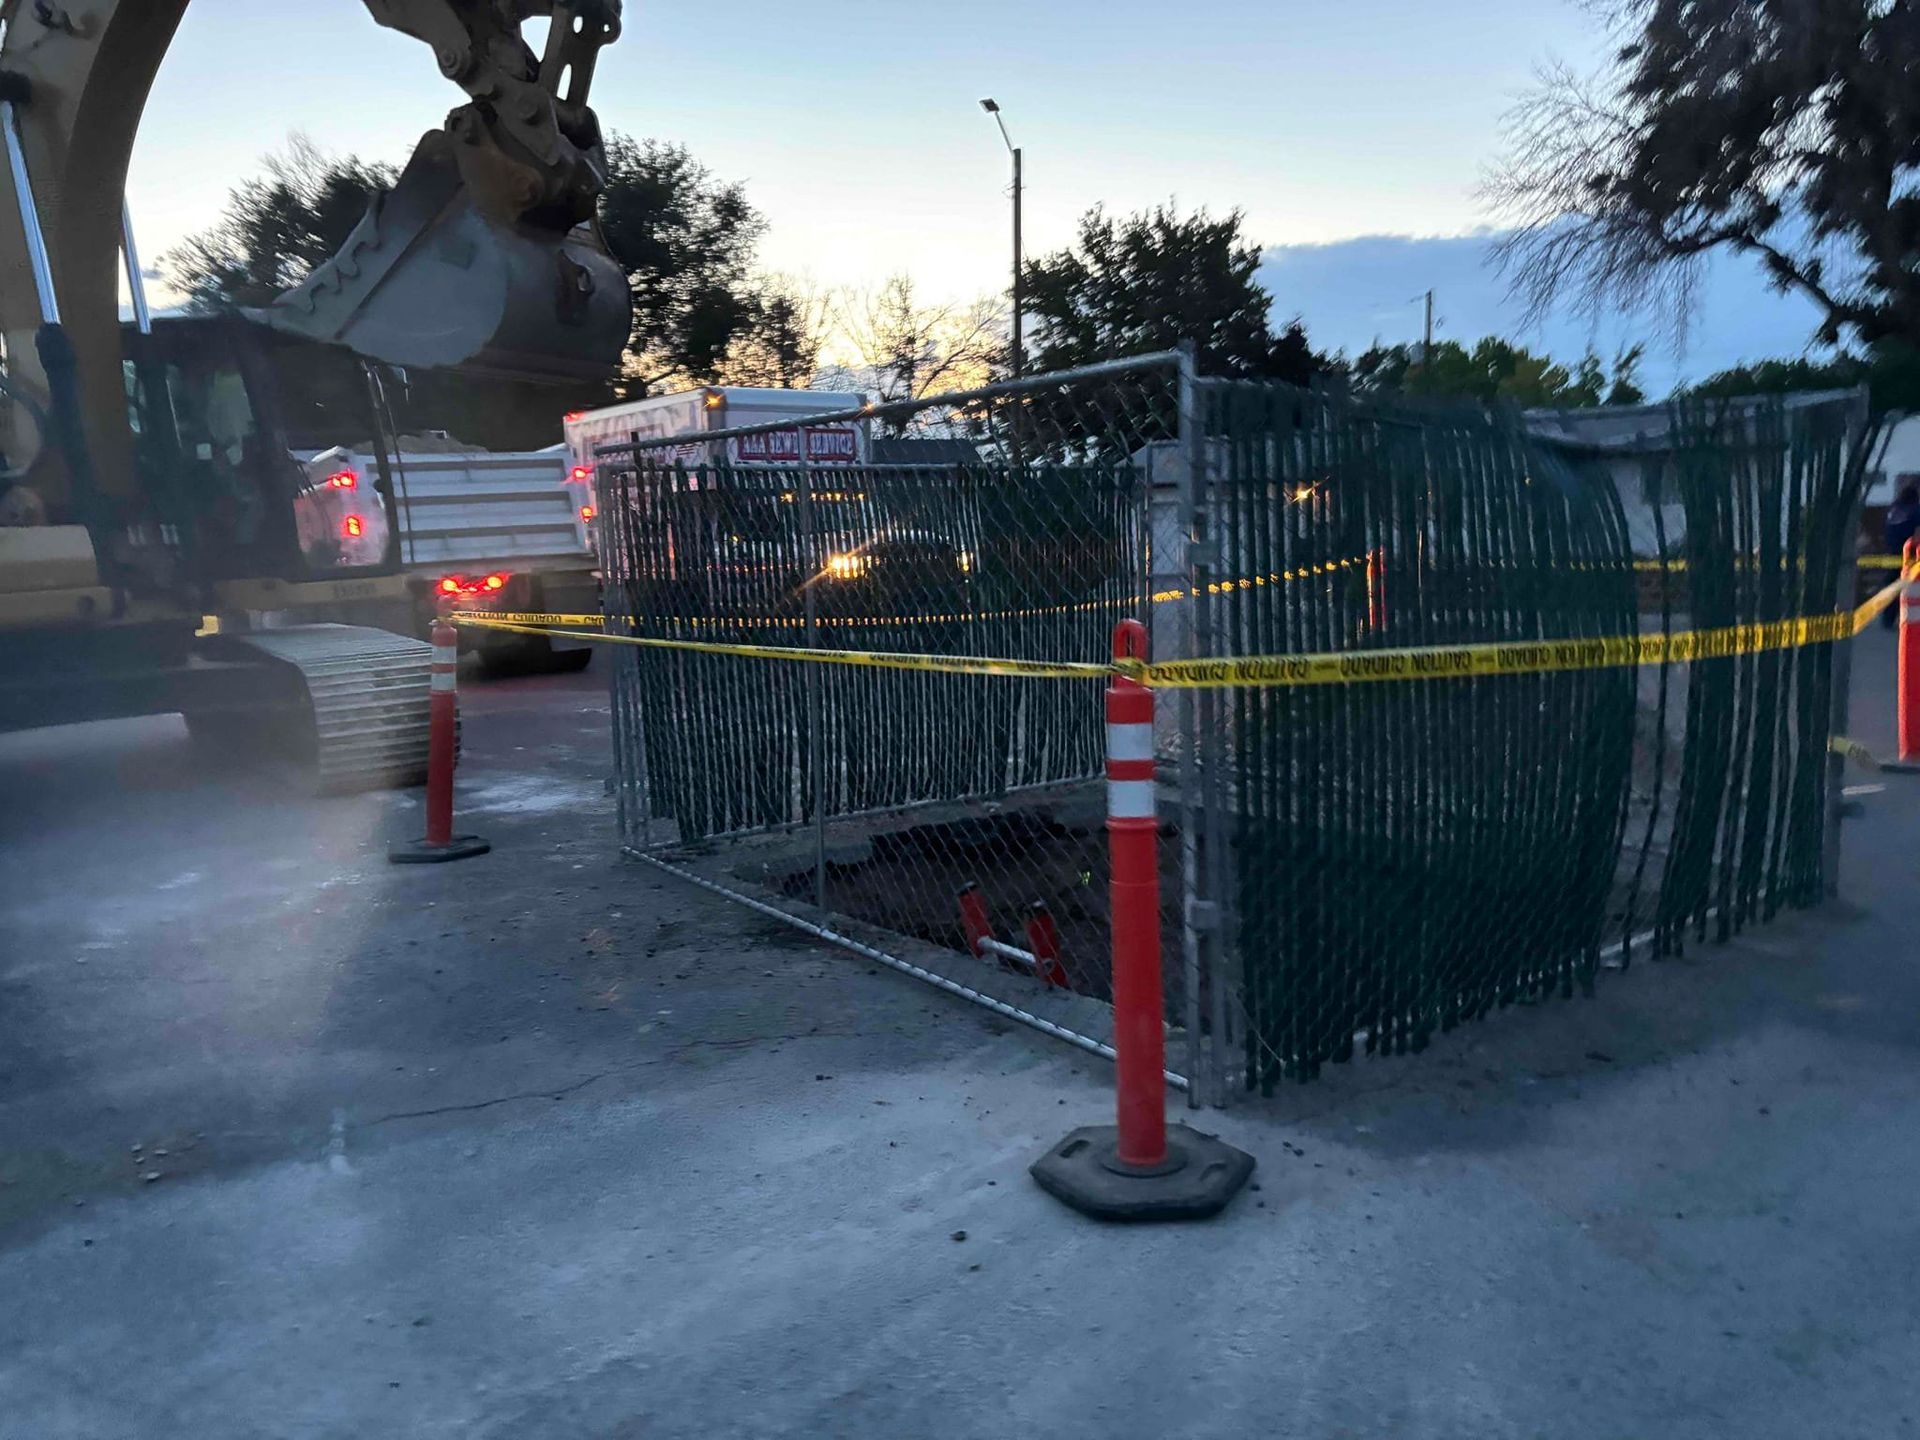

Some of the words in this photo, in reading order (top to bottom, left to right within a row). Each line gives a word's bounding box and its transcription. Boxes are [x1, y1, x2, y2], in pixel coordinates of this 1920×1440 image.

[768, 432, 800, 454] SEWE
[809, 433, 853, 455] SERVICE
[1340, 655, 1406, 676] CUIDADO
[1411, 652, 1472, 673] CAUTION
[1497, 646, 1551, 667] CUIDADO
[1148, 662, 1228, 682] CUIDADO
[1234, 660, 1309, 681] CAUTION
